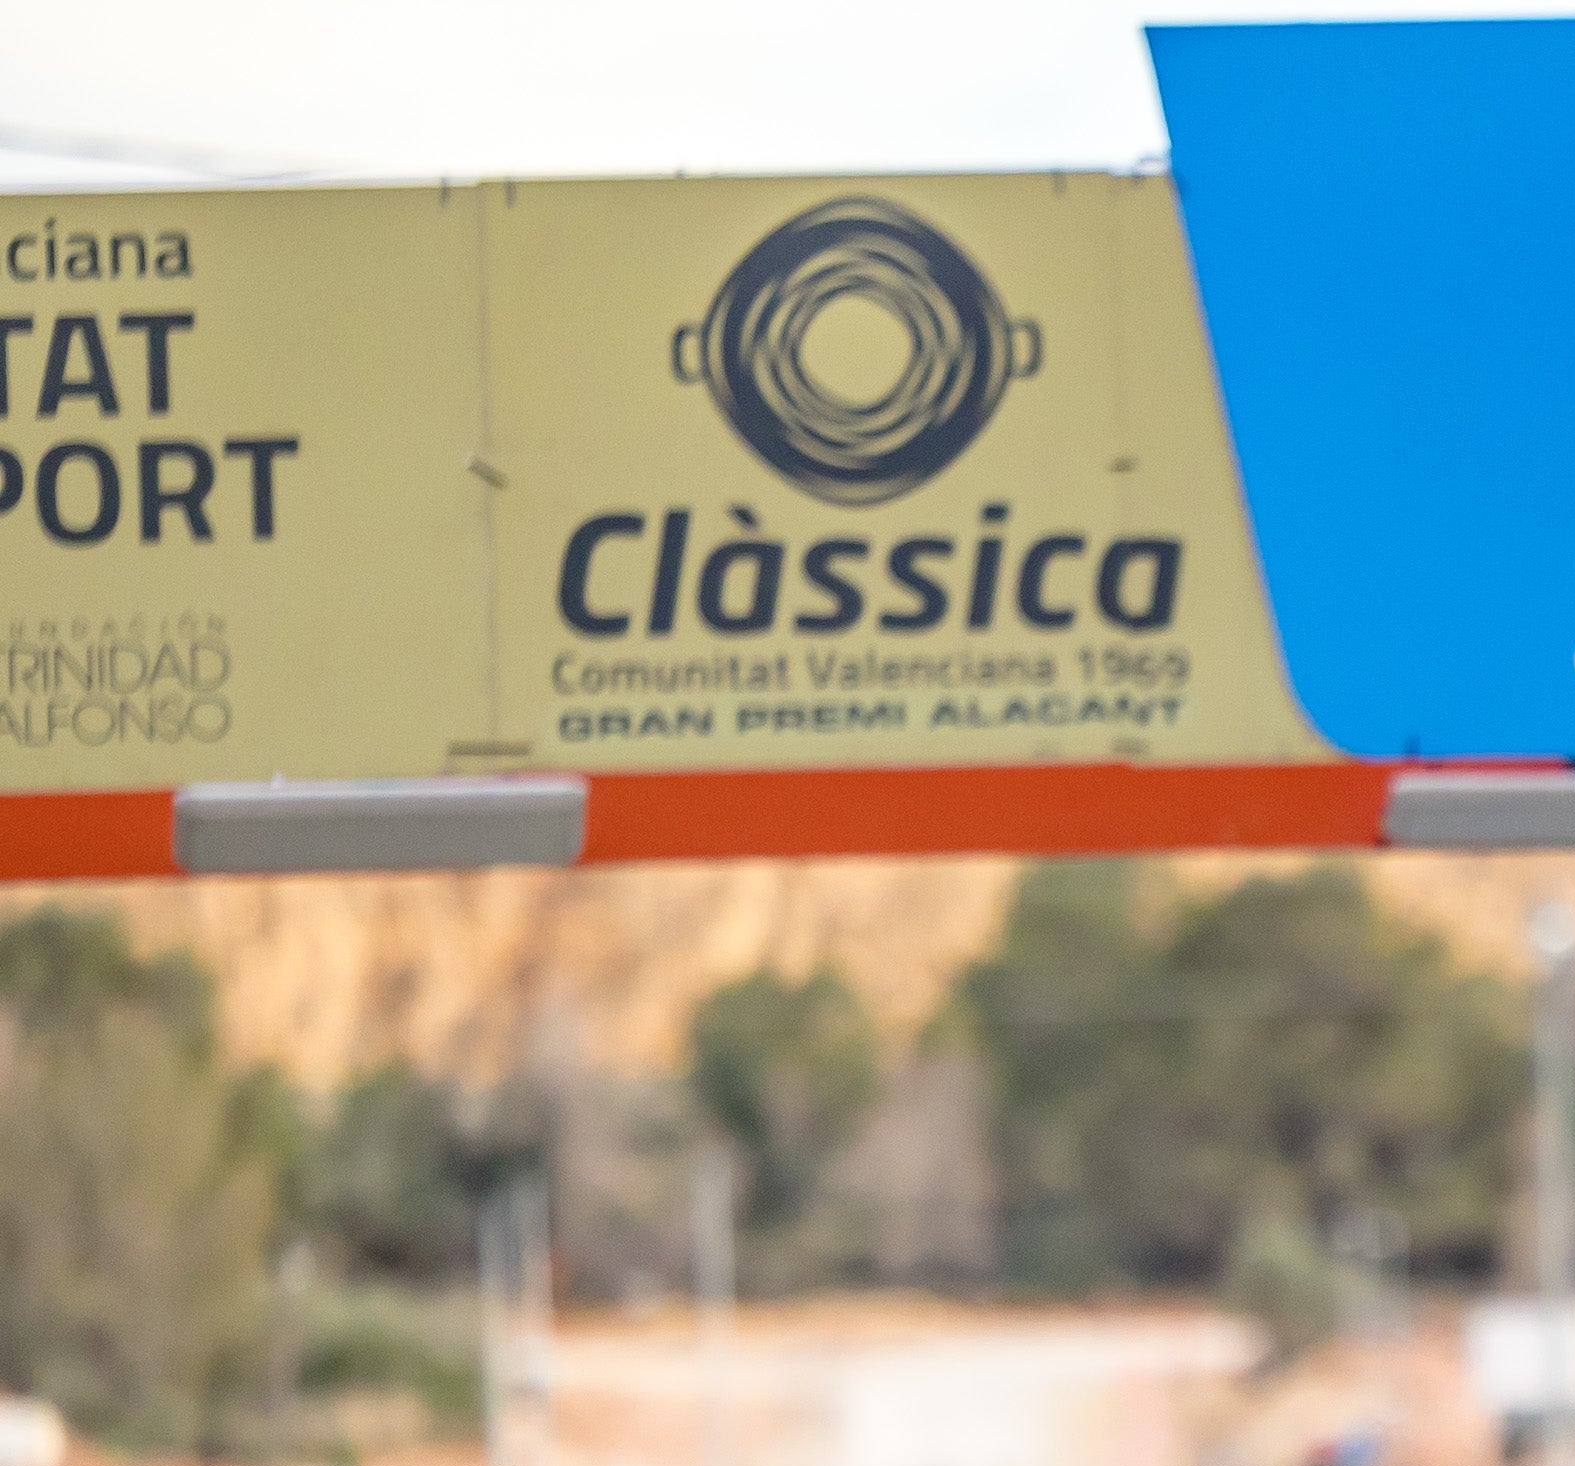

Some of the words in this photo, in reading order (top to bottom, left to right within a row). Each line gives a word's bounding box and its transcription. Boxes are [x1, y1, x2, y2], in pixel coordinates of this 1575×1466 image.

[557, 503, 1183, 638] Clàssica
[551, 650, 792, 696] Comunitat
[804, 645, 1058, 692] Valenciana
[559, 706, 714, 743] GRAN
[736, 696, 907, 734] PREMI
[929, 693, 1181, 730] ALACANT
